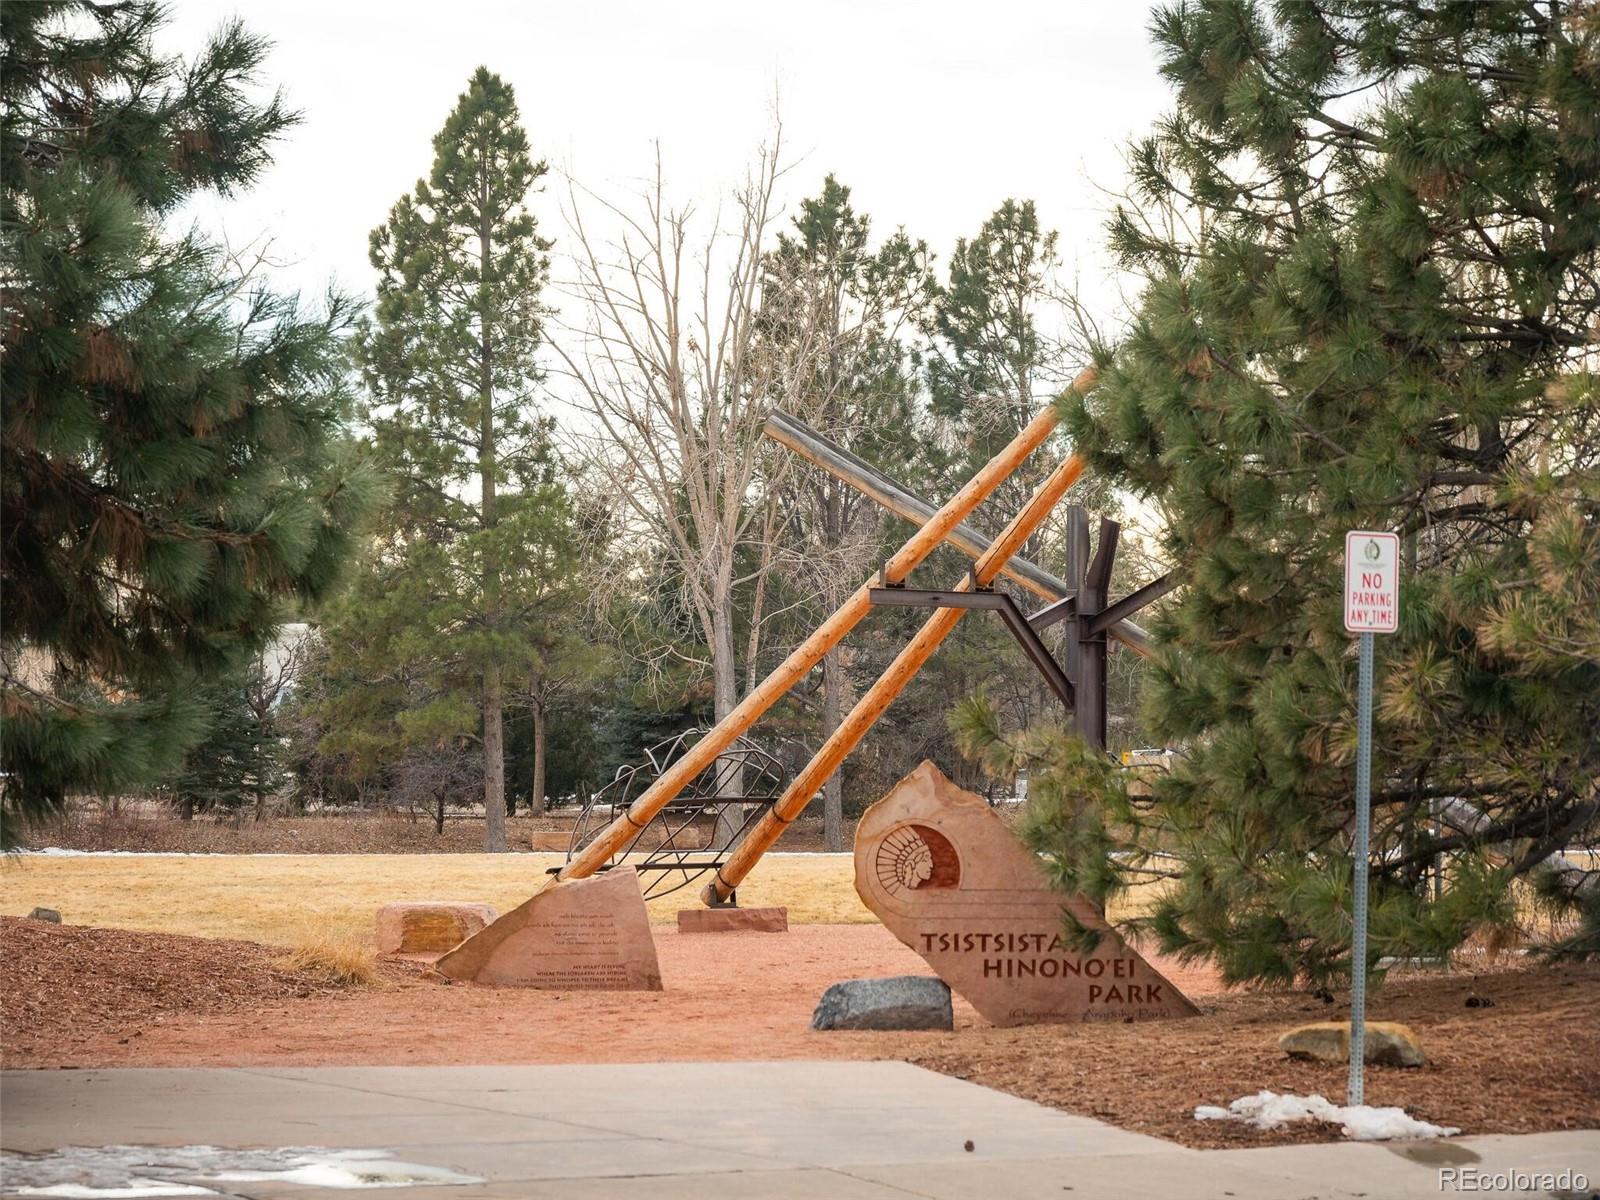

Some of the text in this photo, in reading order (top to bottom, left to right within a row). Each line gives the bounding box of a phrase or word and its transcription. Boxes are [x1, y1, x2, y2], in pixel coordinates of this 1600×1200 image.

[1362, 572, 1383, 590] NO
[1352, 591, 1393, 608] PARKING
[1350, 609, 1393, 625] ANY TIME
[983, 958, 1135, 979] HINONO'EI
[1088, 984, 1163, 1004] PARK
